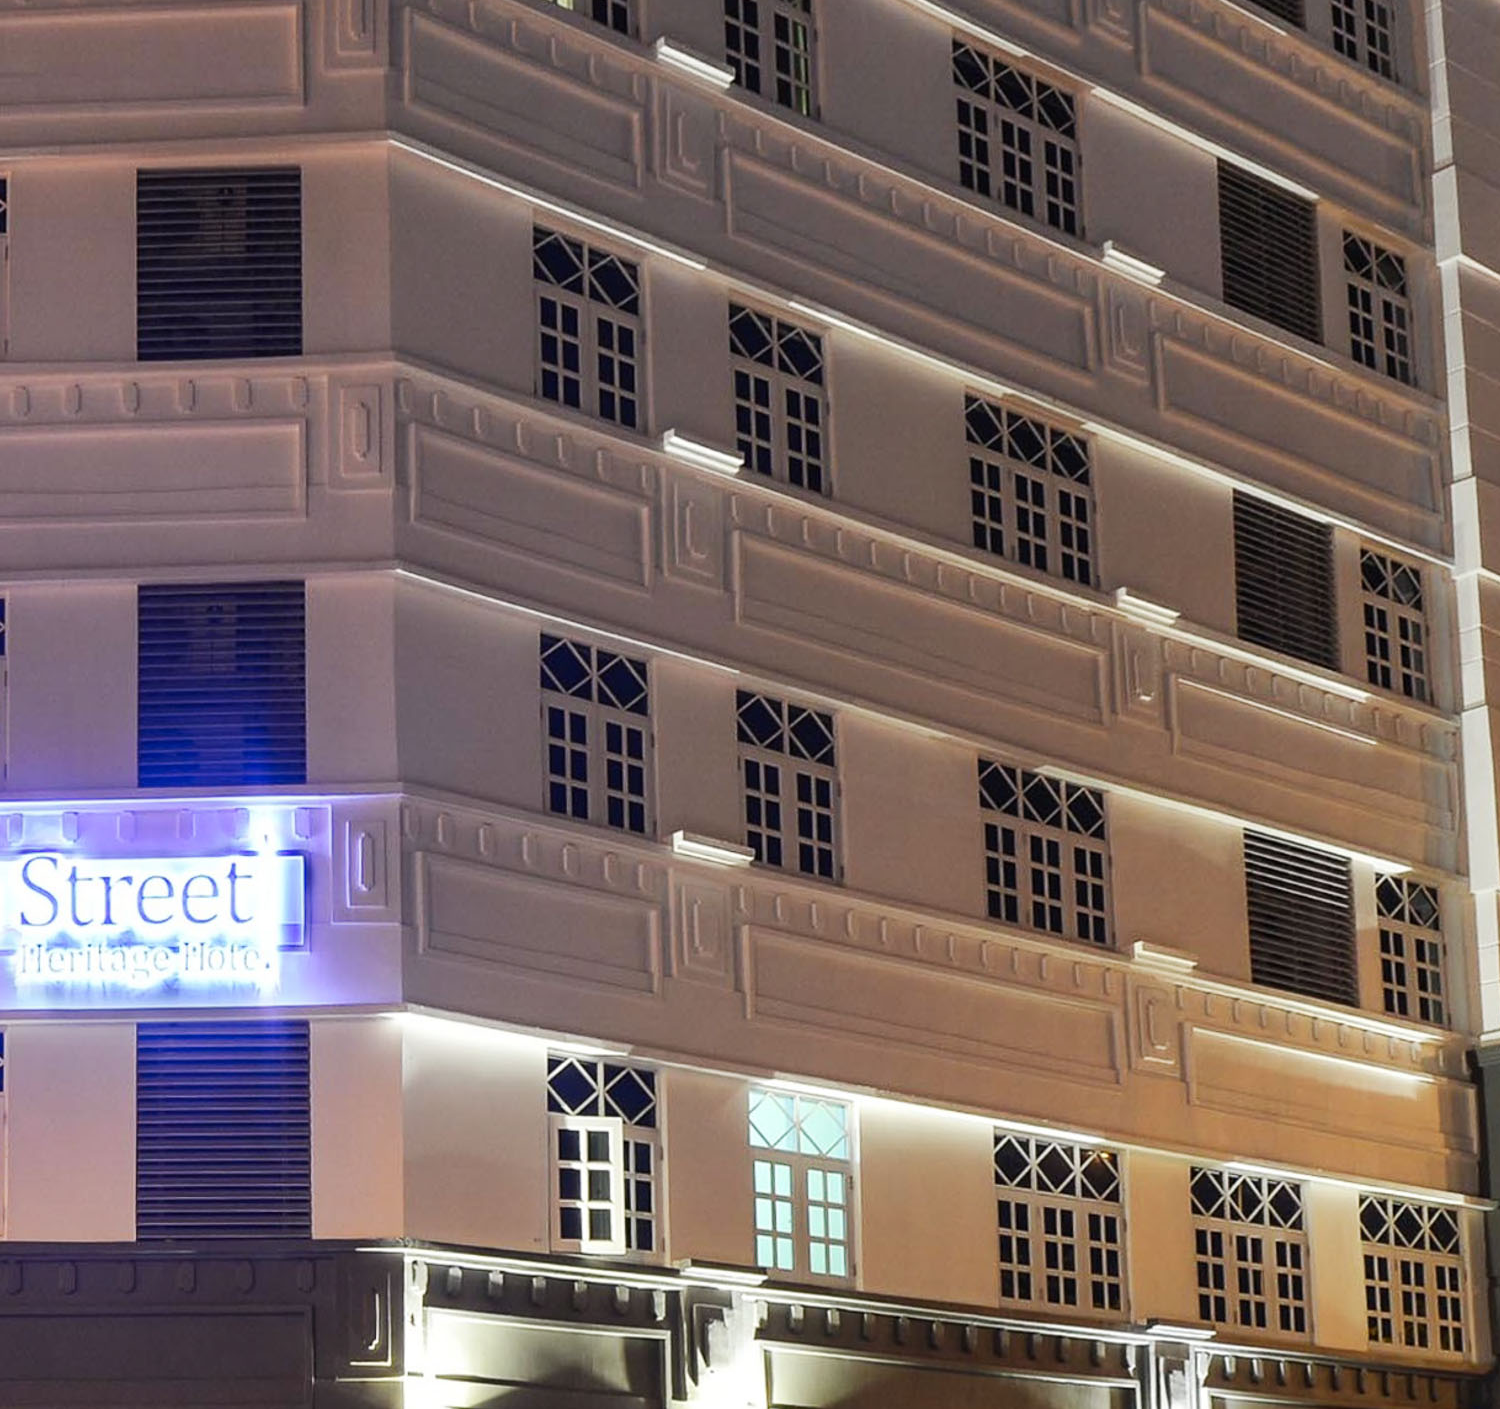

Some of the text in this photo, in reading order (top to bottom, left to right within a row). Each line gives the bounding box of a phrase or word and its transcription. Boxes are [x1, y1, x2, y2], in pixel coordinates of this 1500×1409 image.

[18, 854, 254, 929] Street
[21, 941, 272, 979] Heritage Hote
